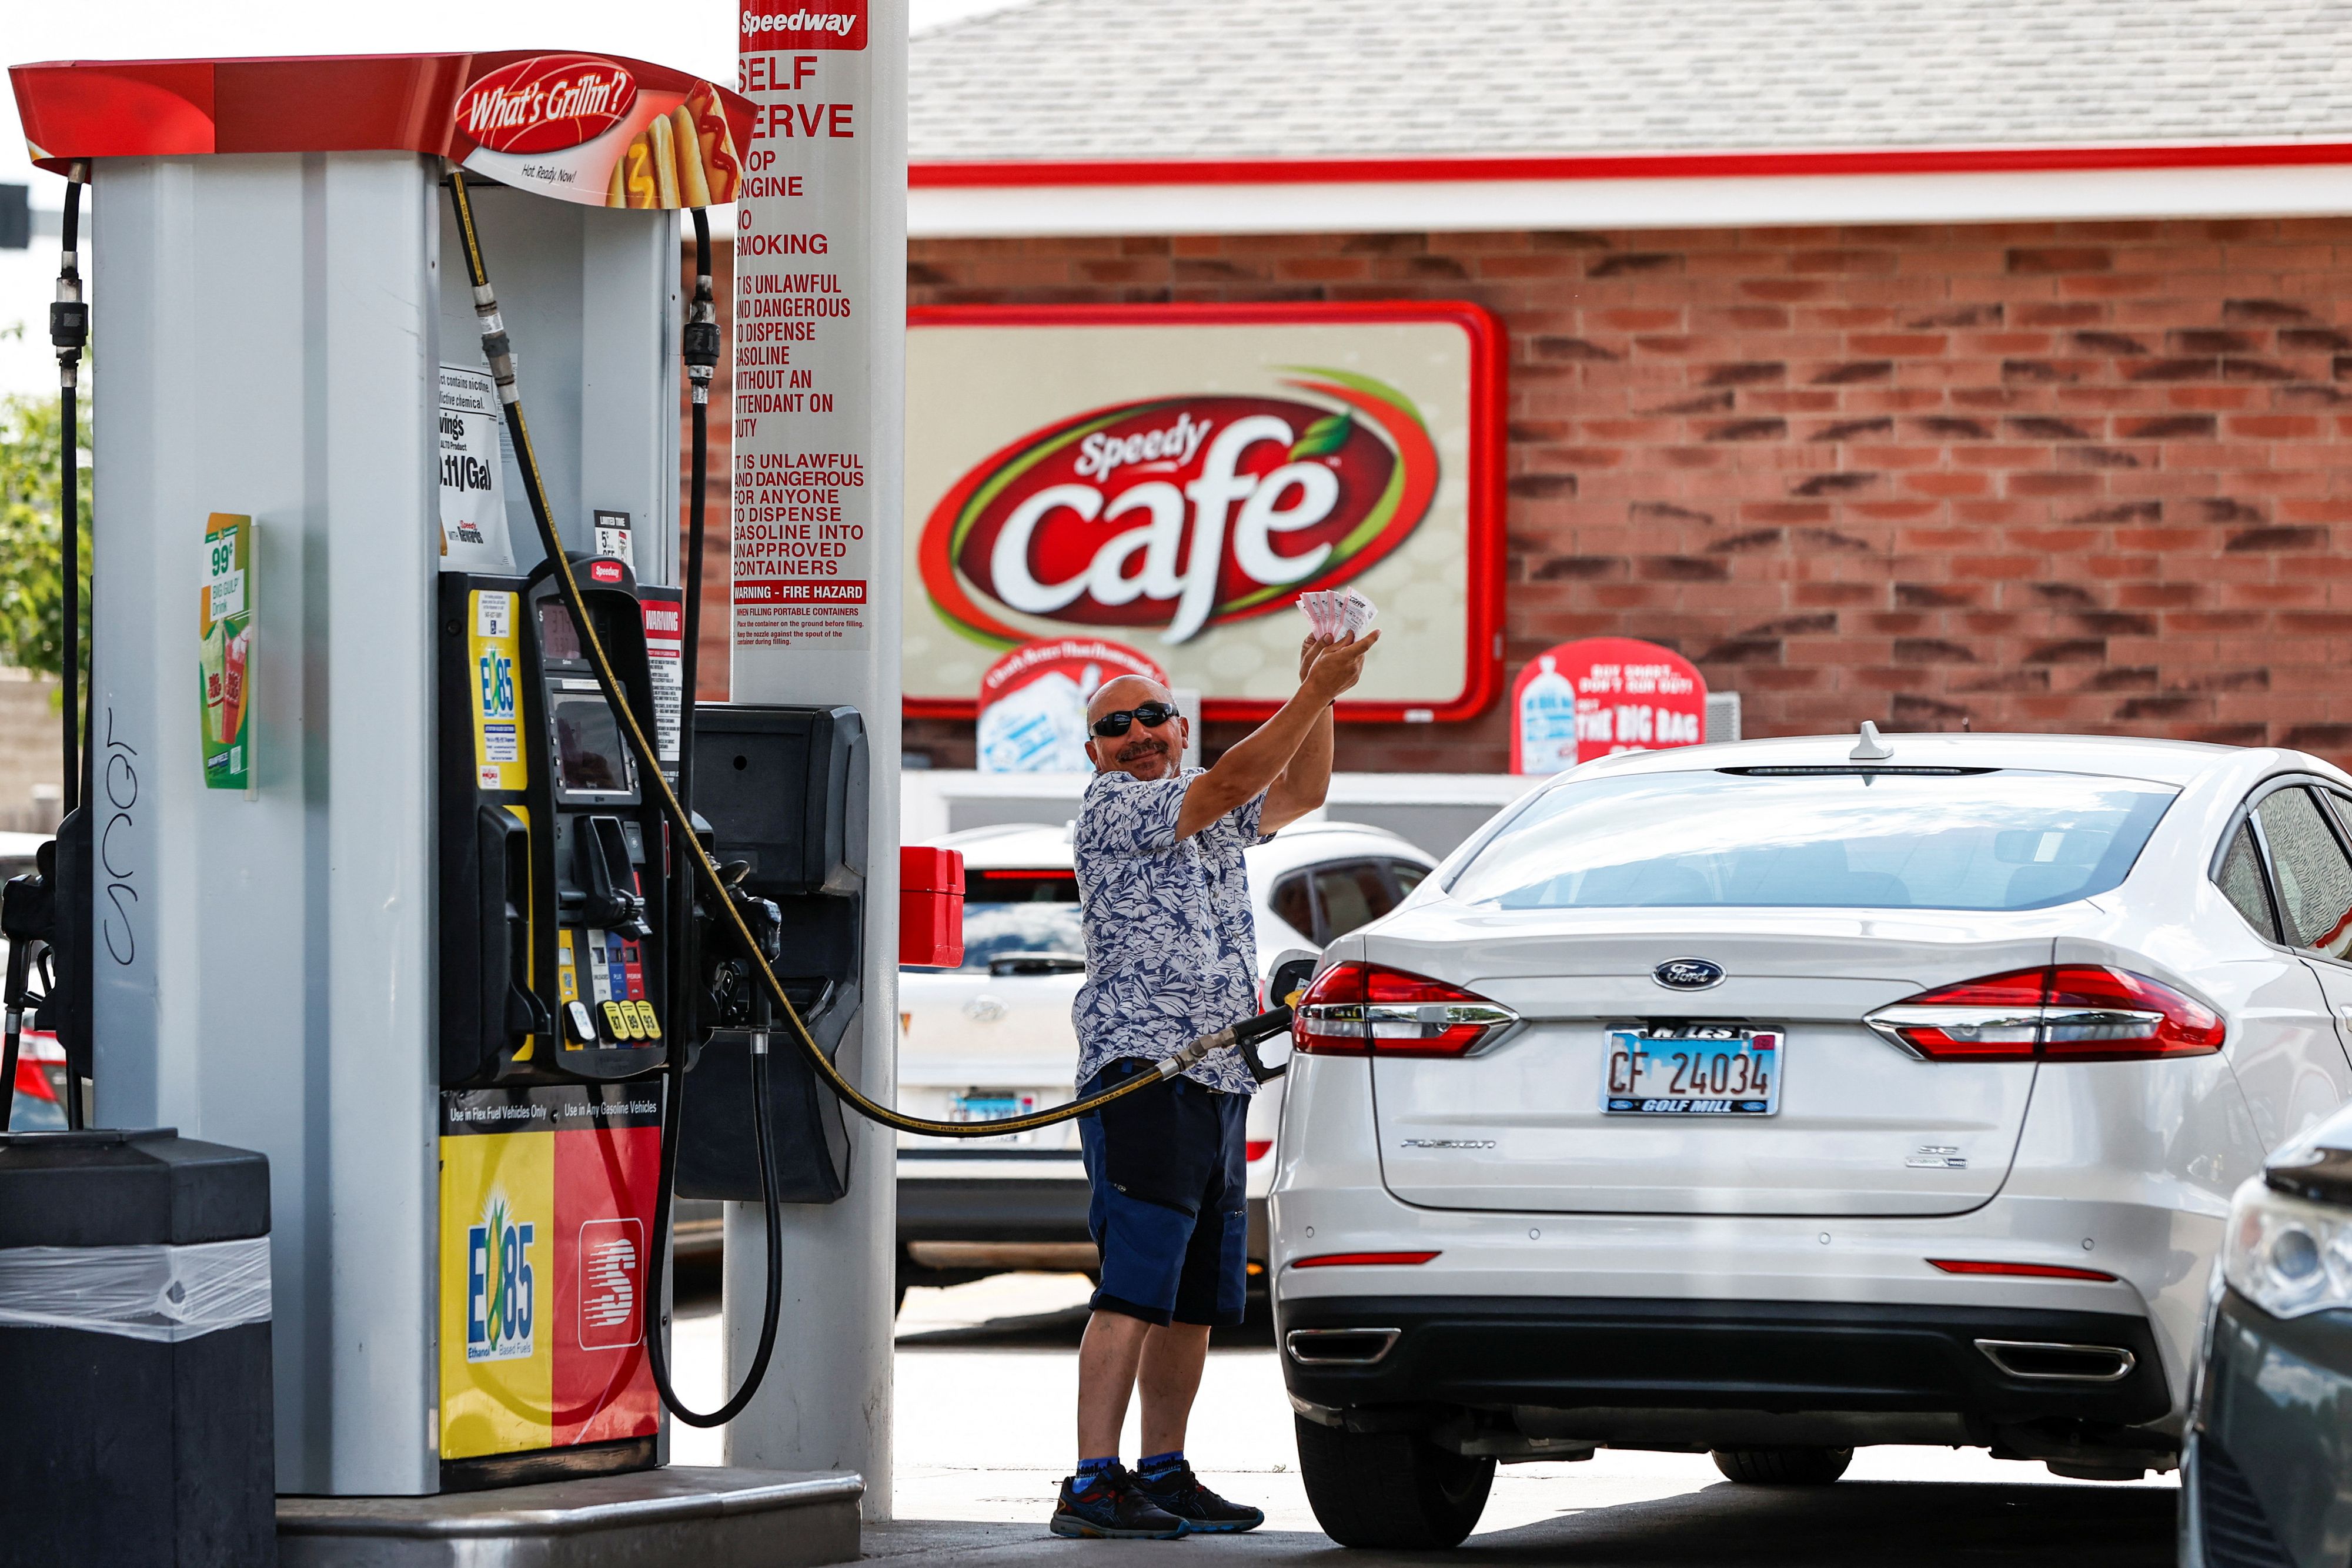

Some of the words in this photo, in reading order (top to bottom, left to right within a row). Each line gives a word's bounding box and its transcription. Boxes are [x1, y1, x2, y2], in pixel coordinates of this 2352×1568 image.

[741, 8, 857, 38] Speedway
[468, 80, 542, 133] What's
[546, 71, 627, 120] Grillin'?
[751, 103, 854, 139] ERVE
[743, 151, 776, 172] OP
[536, 165, 556, 182] Ready.
[557, 168, 576, 183] Now!
[737, 276, 741, 295] T
[743, 275, 751, 295] IS
[755, 274, 842, 294] UNLAWFUL
[754, 297, 851, 318] DANGEROUS
[746, 322, 816, 342] DISPENSE
[446, 376, 468, 389] contains
[468, 378, 490, 393] nicotine.
[789, 369, 812, 389] AN
[439, 390, 455, 406] ictive
[456, 394, 485, 410] chemical.
[809, 393, 833, 413] ON
[450, 441, 467, 452] Product
[1074, 412, 1214, 484] Speedy
[736, 455, 741, 470] T
[744, 454, 755, 469] IS
[760, 453, 864, 469] UNLAWFUL
[735, 472, 753, 487] AND
[756, 471, 864, 487] DANGEROUS
[735, 490, 754, 505] FOR
[759, 489, 839, 504] ANYONE
[749, 507, 841, 522] DISPENSE
[734, 524, 811, 541] GASOLINE
[819, 524, 864, 540] INTO
[734, 542, 847, 558] UNAPPROVED
[596, 565, 620, 579] Speedway
[734, 560, 838, 576] CONTAINERS
[734, 586, 771, 599] WARNING
[783, 586, 810, 599] FIRE
[814, 586, 863, 599] HAZARD
[737, 608, 749, 616] WHEN
[750, 608, 772, 616] FILLING
[773, 608, 811, 616] PORTABLE
[813, 607, 859, 616] CONTAINERS
[646, 610, 679, 632] WARNING
[773, 638, 791, 646] filling.
[480, 657, 514, 711] E85
[1616, 704, 1653, 743] BIG
[1667, 963, 1709, 983] Ford
[611, 1015, 622, 1030] 87
[627, 1015, 639, 1029] 89
[643, 1015, 655, 1029] 93
[1609, 1052, 1649, 1094] CF
[1669, 1053, 1768, 1095] 24034
[1094, 1091, 1120, 1105] FUTURA
[1641, 1099, 1689, 1112] GOLF
[1689, 1100, 1732, 1112] MILL
[450, 1108, 463, 1122] Use
[464, 1108, 472, 1121] in
[473, 1106, 486, 1121] Flex
[487, 1106, 501, 1120] Fuel
[502, 1105, 530, 1119] Vehicles
[531, 1104, 547, 1120] Only
[564, 1103, 577, 1117] Use
[579, 1102, 585, 1116] in
[586, 1102, 599, 1118] Any
[601, 1101, 629, 1115] Gasoline
[630, 1100, 657, 1114] Vehicles
[1917, 1145, 1959, 1155] SE
[469, 1224, 534, 1345] E85
[469, 1345, 491, 1359] Ethanol
[499, 1342, 516, 1356] Based
[517, 1339, 531, 1354] Fuels
